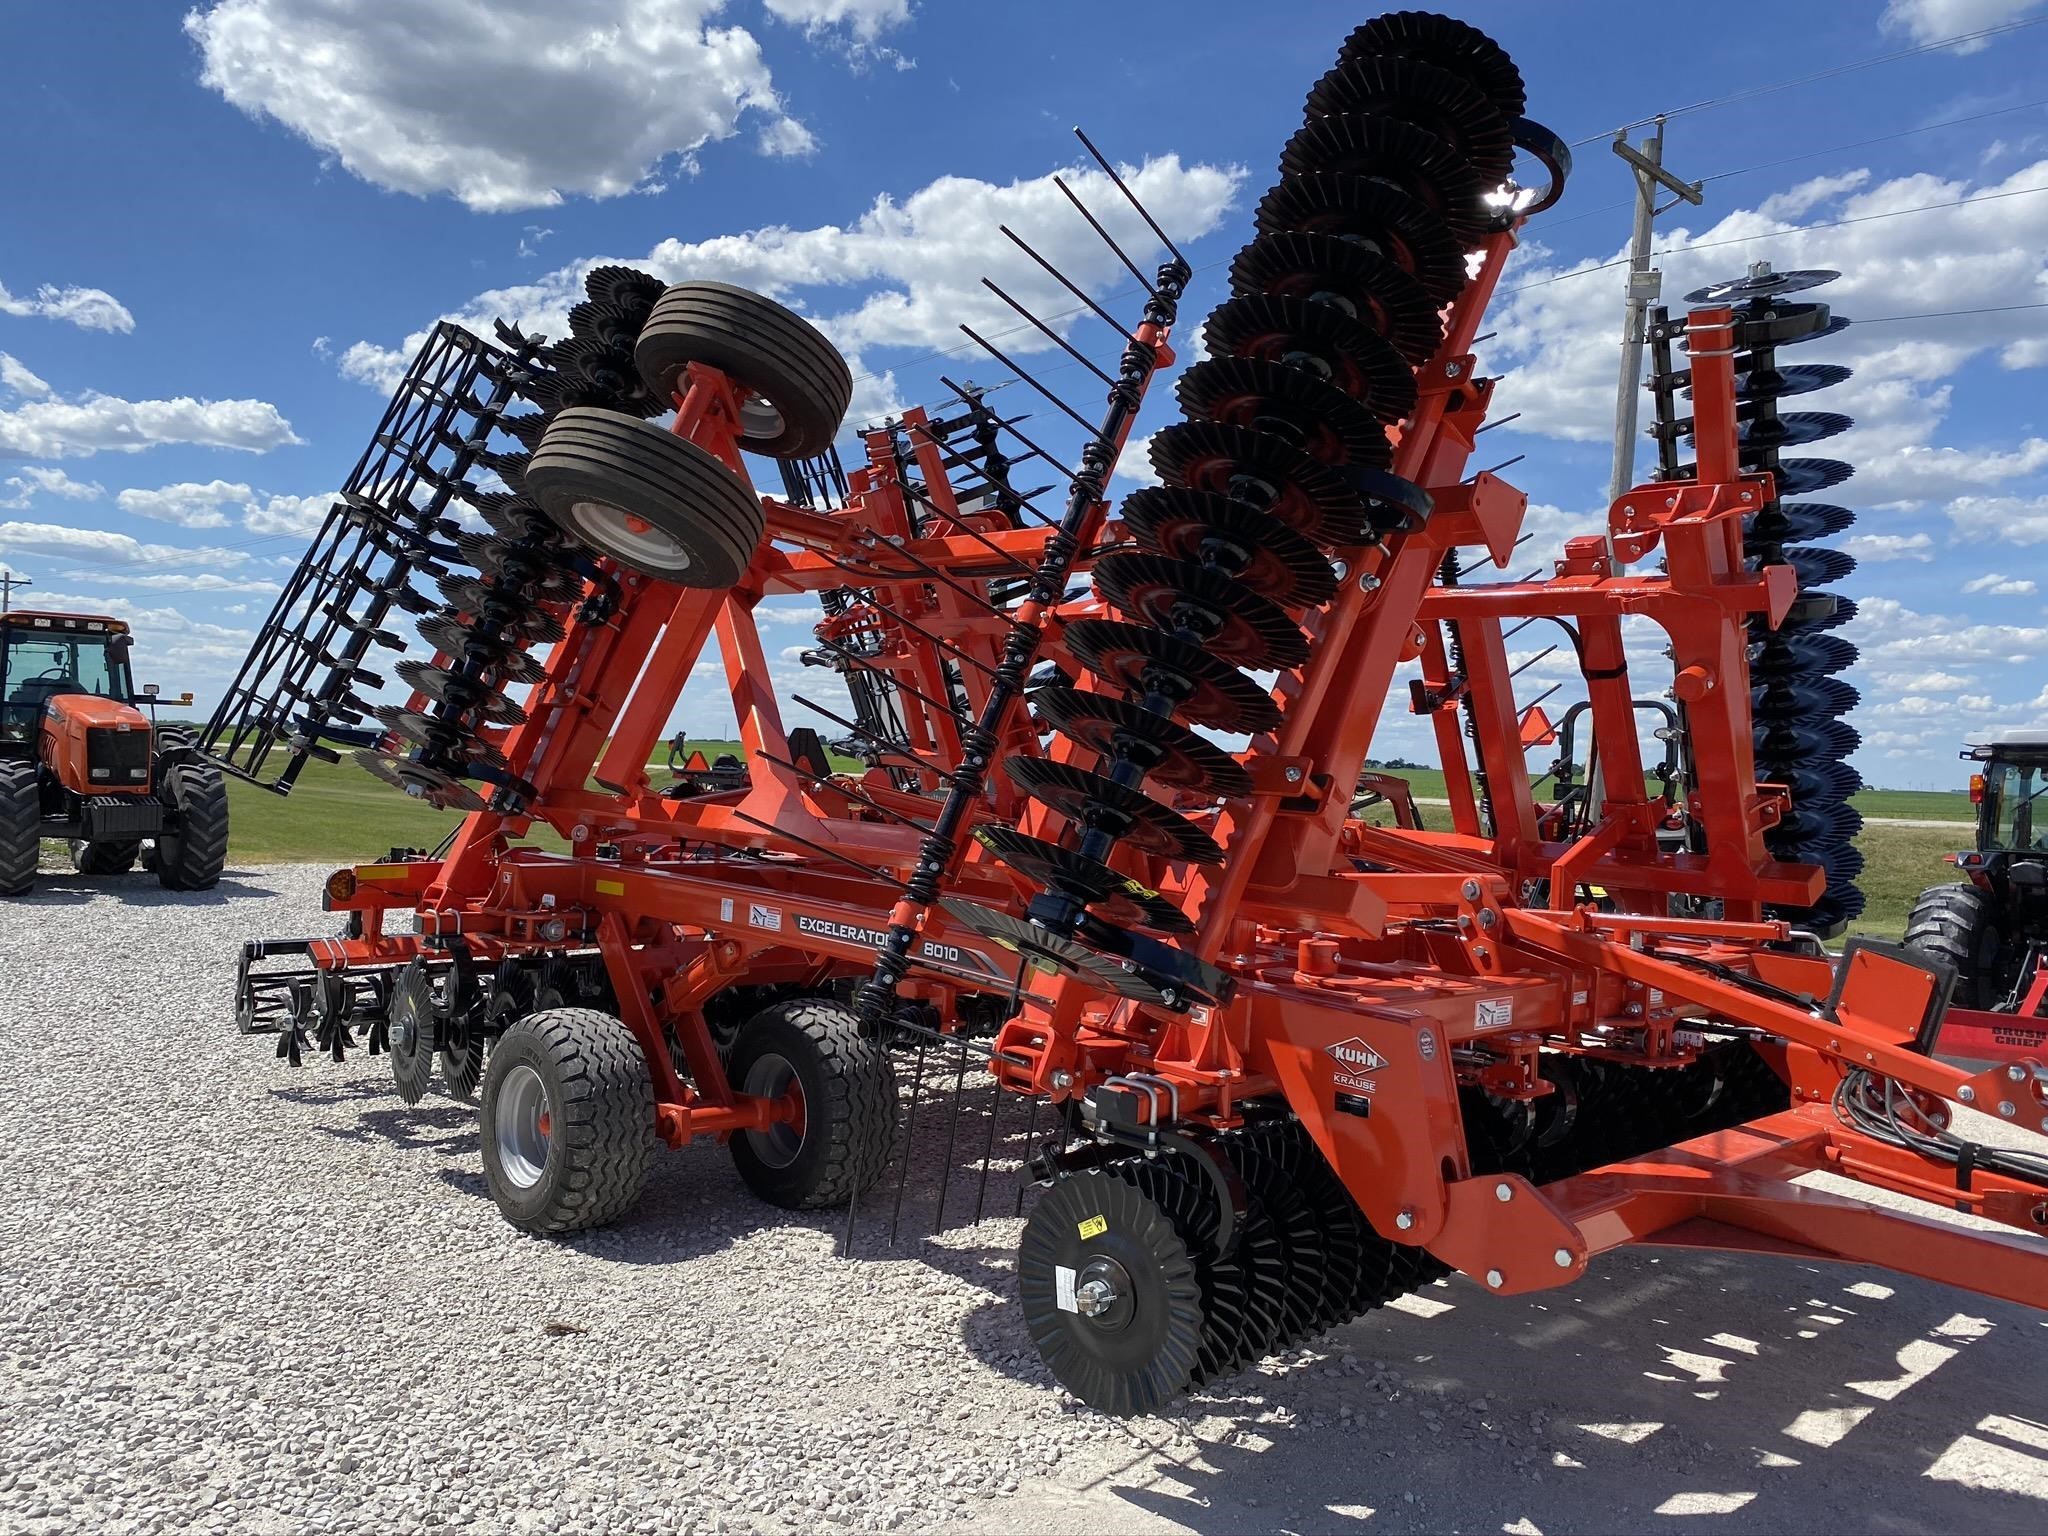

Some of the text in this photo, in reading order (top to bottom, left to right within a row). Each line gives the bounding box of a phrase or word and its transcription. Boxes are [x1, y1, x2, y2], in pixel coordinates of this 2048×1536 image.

[924, 942, 958, 962] 8010
[1992, 1027, 2047, 1039] BRUSH
[1995, 1036, 2043, 1047] CHIEF
[1335, 1046, 1378, 1067] KUHN
[1334, 1074, 1376, 1091] KRAUSE
